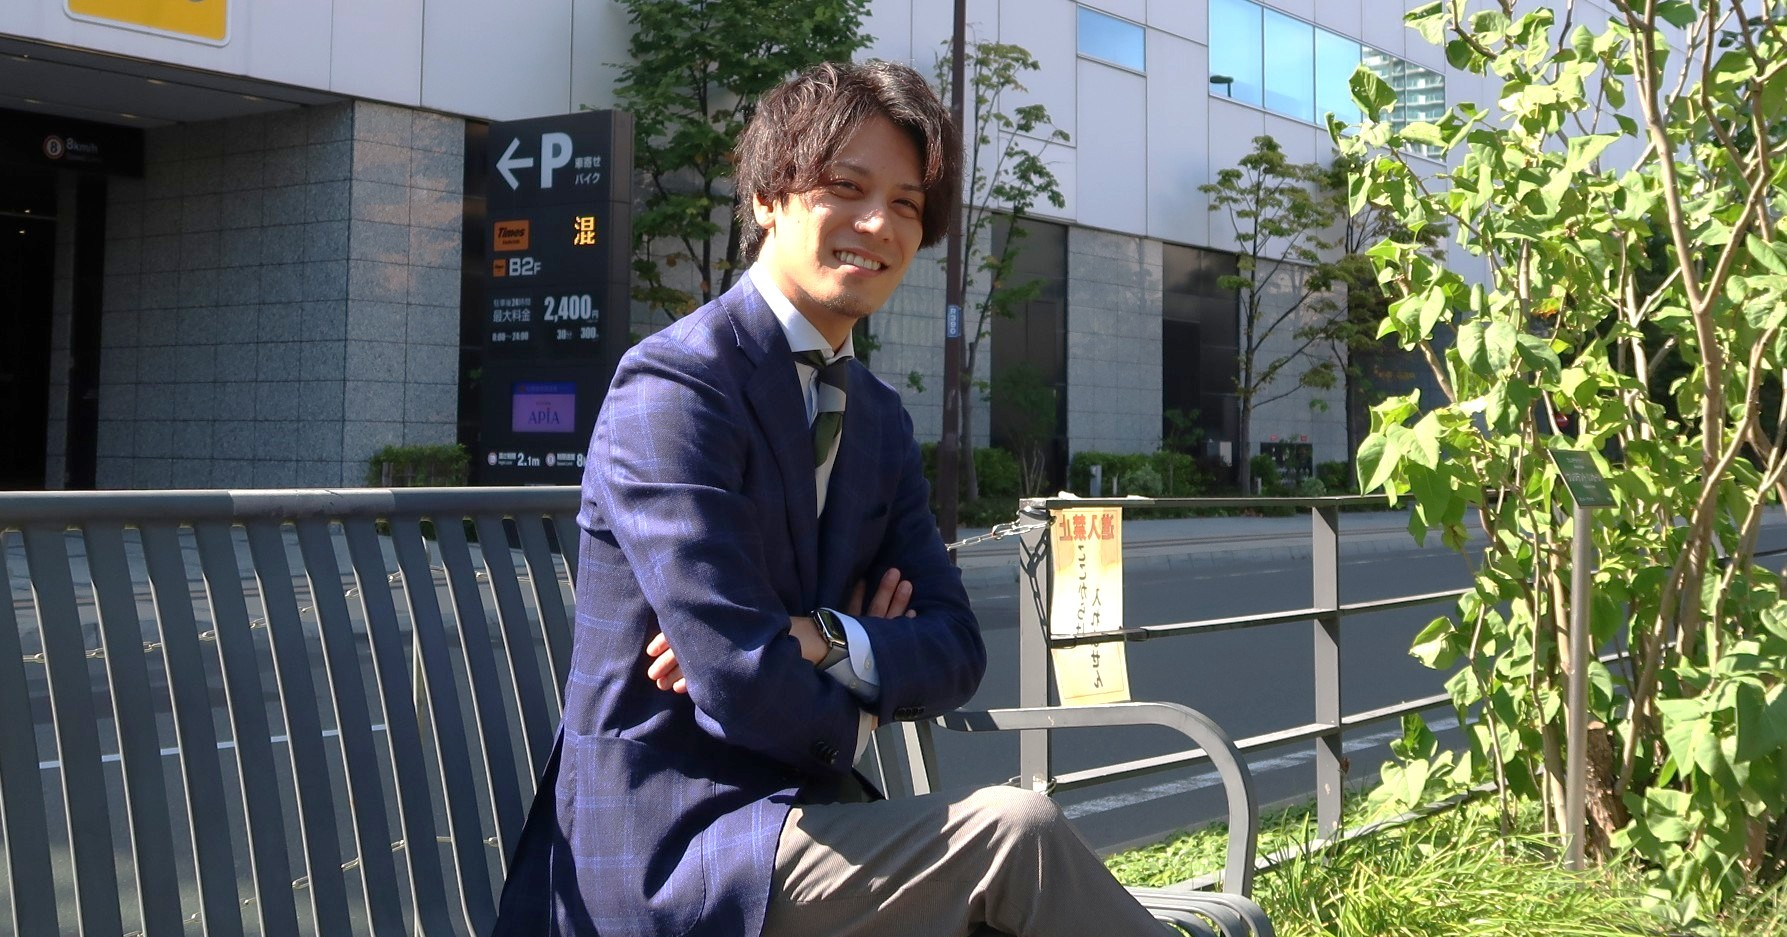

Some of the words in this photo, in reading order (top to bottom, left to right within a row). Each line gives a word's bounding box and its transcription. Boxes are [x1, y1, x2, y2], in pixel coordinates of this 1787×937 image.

[541, 132, 573, 188] P
[575, 156, 601, 169] 車寄せ
[575, 173, 601, 185] バイク
[498, 227, 526, 238] Times
[574, 216, 595, 245] 混
[509, 257, 541, 276] B2F
[493, 308, 531, 322] 最大料金
